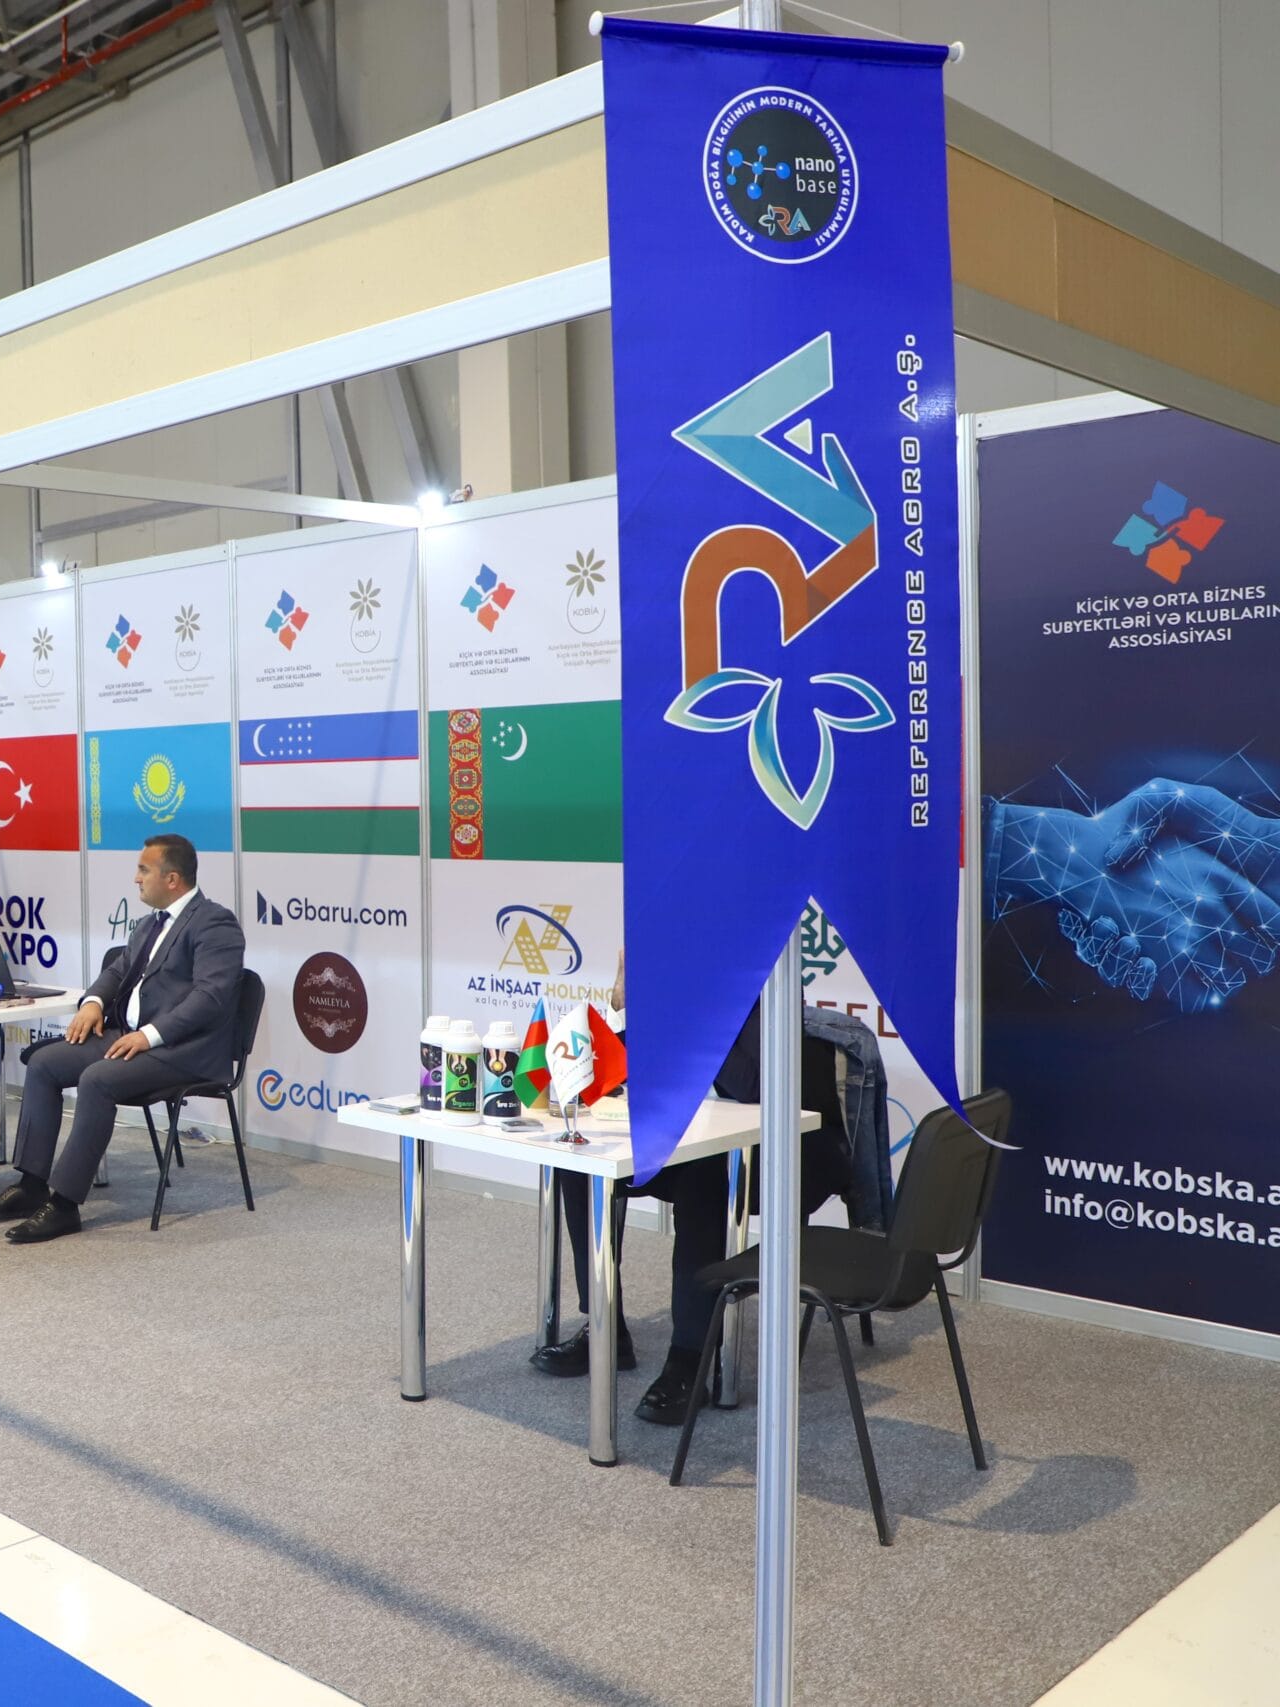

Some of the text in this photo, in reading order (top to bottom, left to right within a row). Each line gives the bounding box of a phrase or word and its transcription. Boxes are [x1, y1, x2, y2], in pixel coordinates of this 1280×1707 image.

[759, 95, 814, 117] MODERN
[814, 113, 848, 164] TARIMA
[794, 156, 836, 173] nano
[709, 160, 725, 201] DOĞA
[795, 173, 837, 195] base
[814, 168, 852, 247] UYGULAMASI
[720, 203, 756, 243] KADİM
[897, 334, 928, 827] REFERENCE AGRO A.Ş.
[1076, 585, 1266, 616] KİÇİK VƏ ORTA BİZNES
[1042, 611, 1151, 635] SUBYEKTLƏRİ
[1154, 612, 1181, 626] VƏ
[1108, 627, 1232, 649] ASSOSİASİYASI
[286, 897, 407, 927] Gbaru.com
[467, 976, 486, 991] AZ
[490, 974, 542, 999] İNŞAAT
